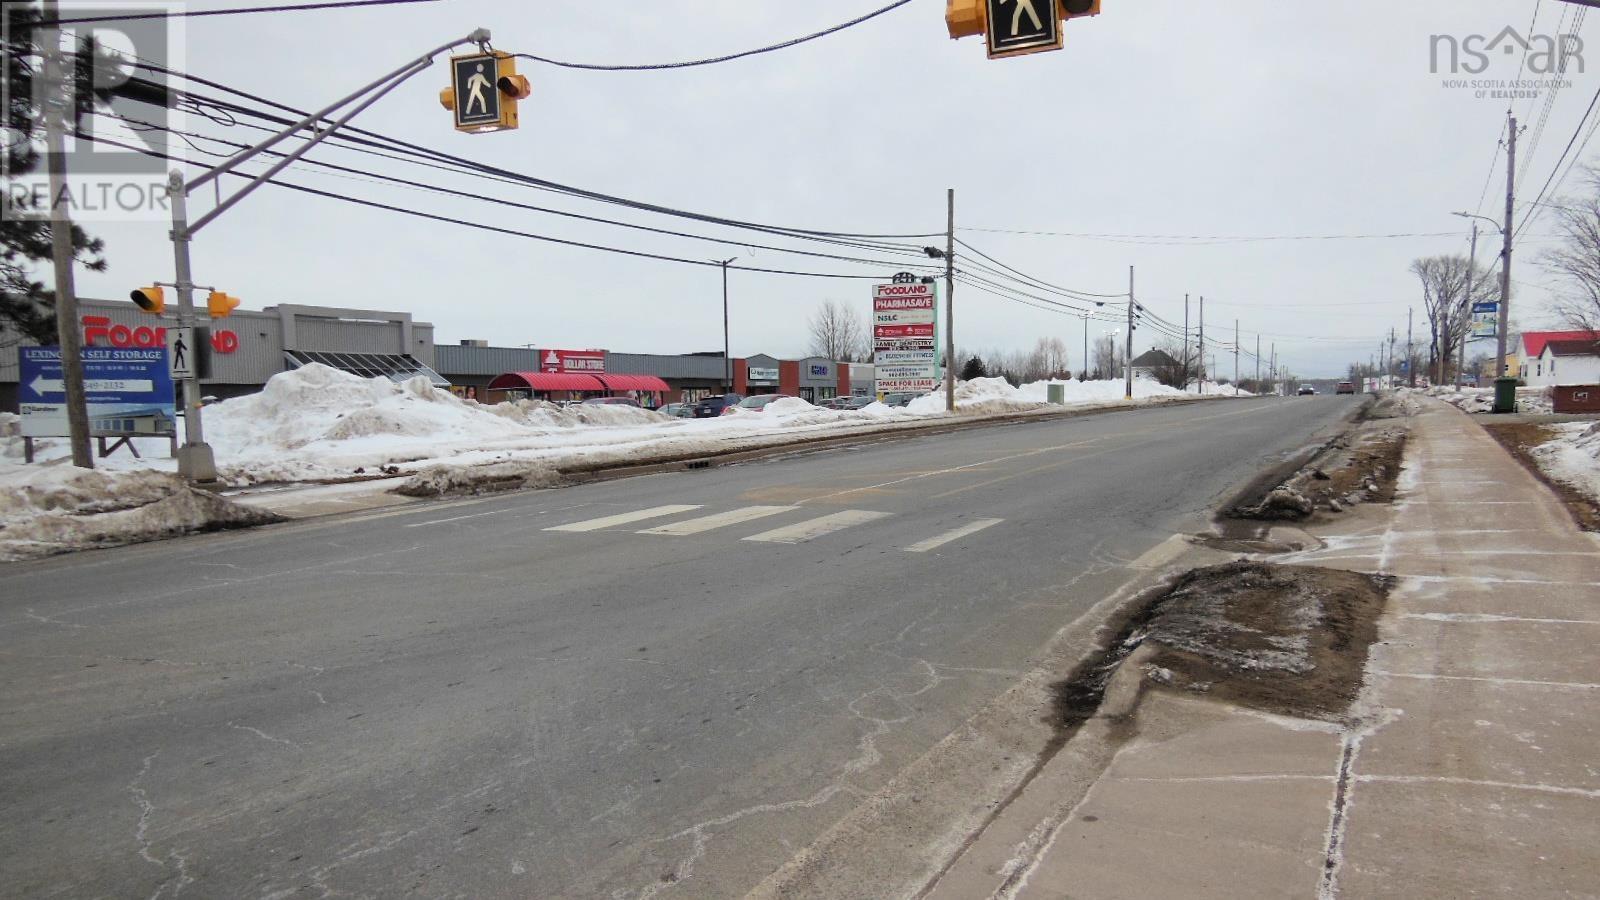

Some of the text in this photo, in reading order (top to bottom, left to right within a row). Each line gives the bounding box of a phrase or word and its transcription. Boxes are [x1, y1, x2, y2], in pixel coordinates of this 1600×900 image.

[878, 285, 927, 295] FOODLAND
[875, 298, 931, 309] PHARMASAVE
[877, 314, 898, 322] NSLC
[87, 350, 111, 359] SELF
[113, 350, 162, 359] STORAGE
